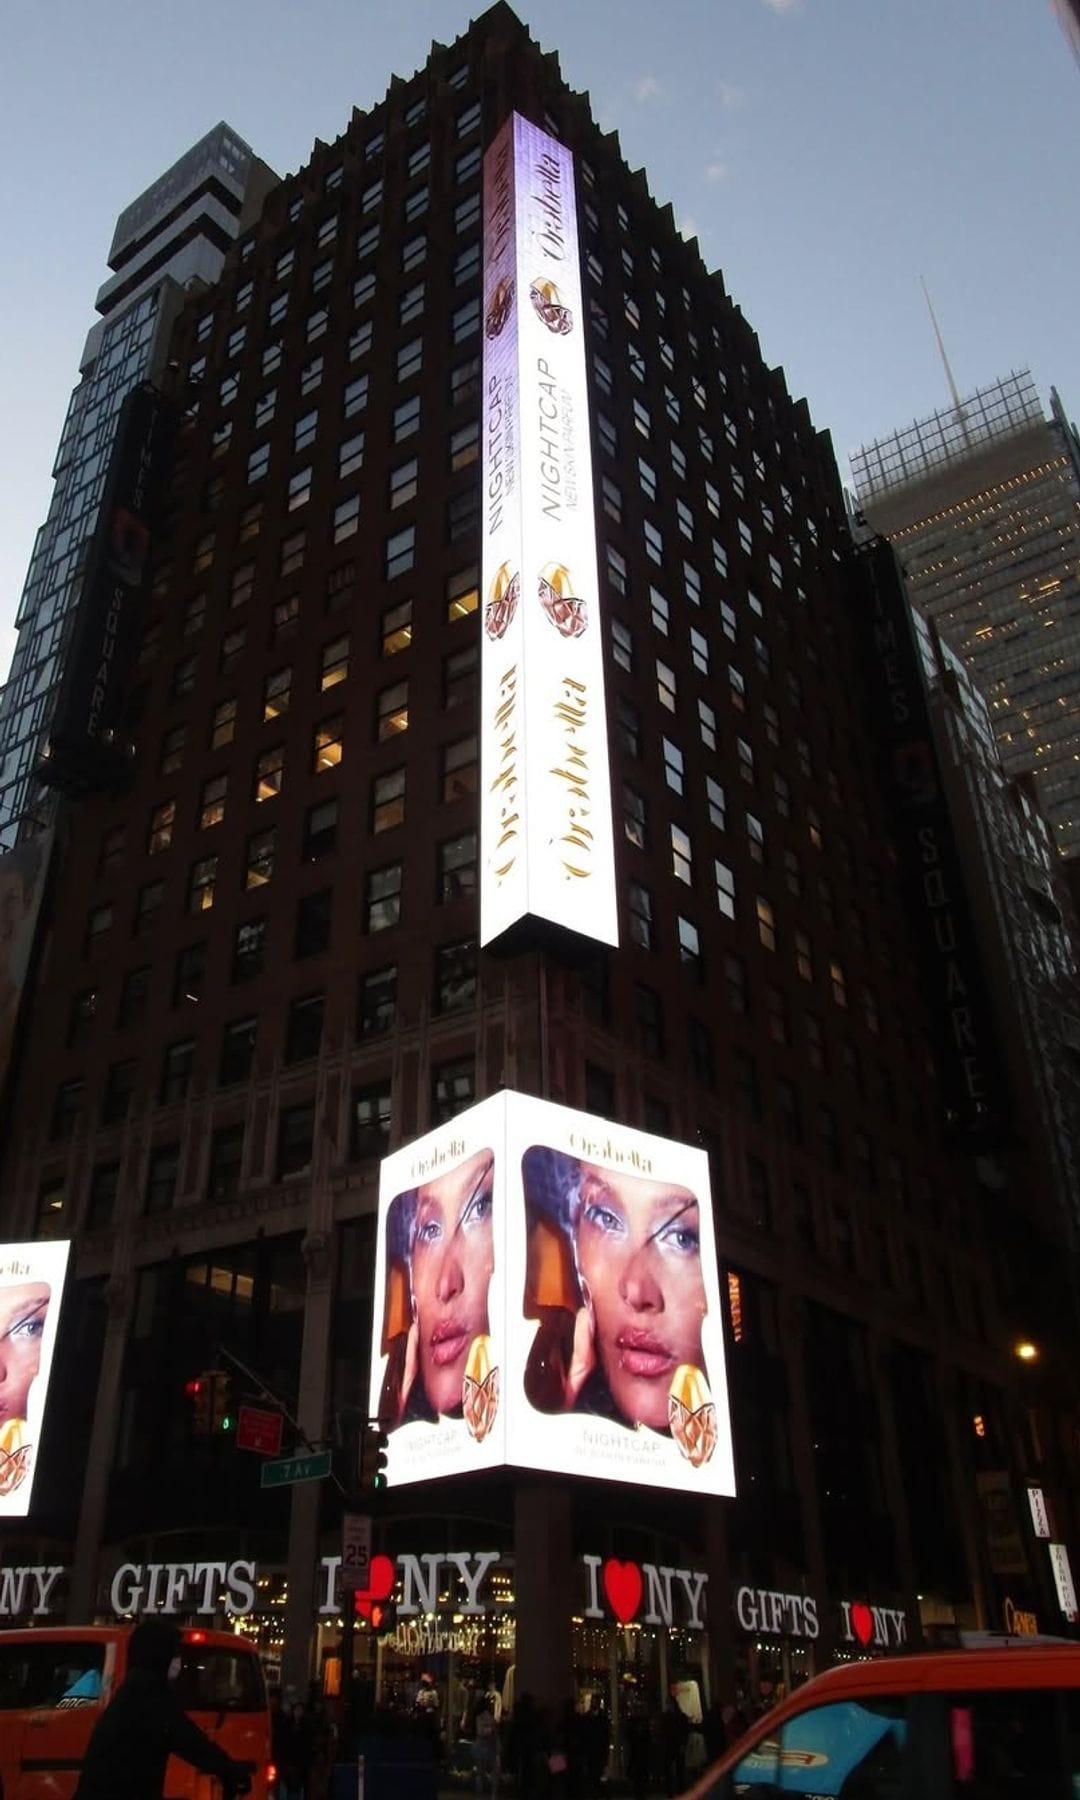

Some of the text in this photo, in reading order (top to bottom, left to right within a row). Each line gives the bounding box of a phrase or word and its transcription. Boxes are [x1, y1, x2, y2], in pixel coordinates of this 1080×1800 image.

[489, 375, 503, 535] NIGHTCAP
[538, 358, 562, 521] NIGHTCAP
[87, 587, 124, 738] SQUARE
[917, 827, 984, 1099] SQUARE
[583, 1430, 660, 1453] NIGHTCAP
[281, 1464, 290, 1478] 7
[1031, 1489, 1047, 1537] PIZZA
[345, 1544, 368, 1566] 25
[0, 1566, 64, 1615] NY
[110, 1559, 257, 1616] GIFTS
[319, 1551, 500, 1616] I NY
[582, 1555, 709, 1630] I NY
[737, 1585, 819, 1639] GIFTS
[841, 1601, 907, 1647] I NY
